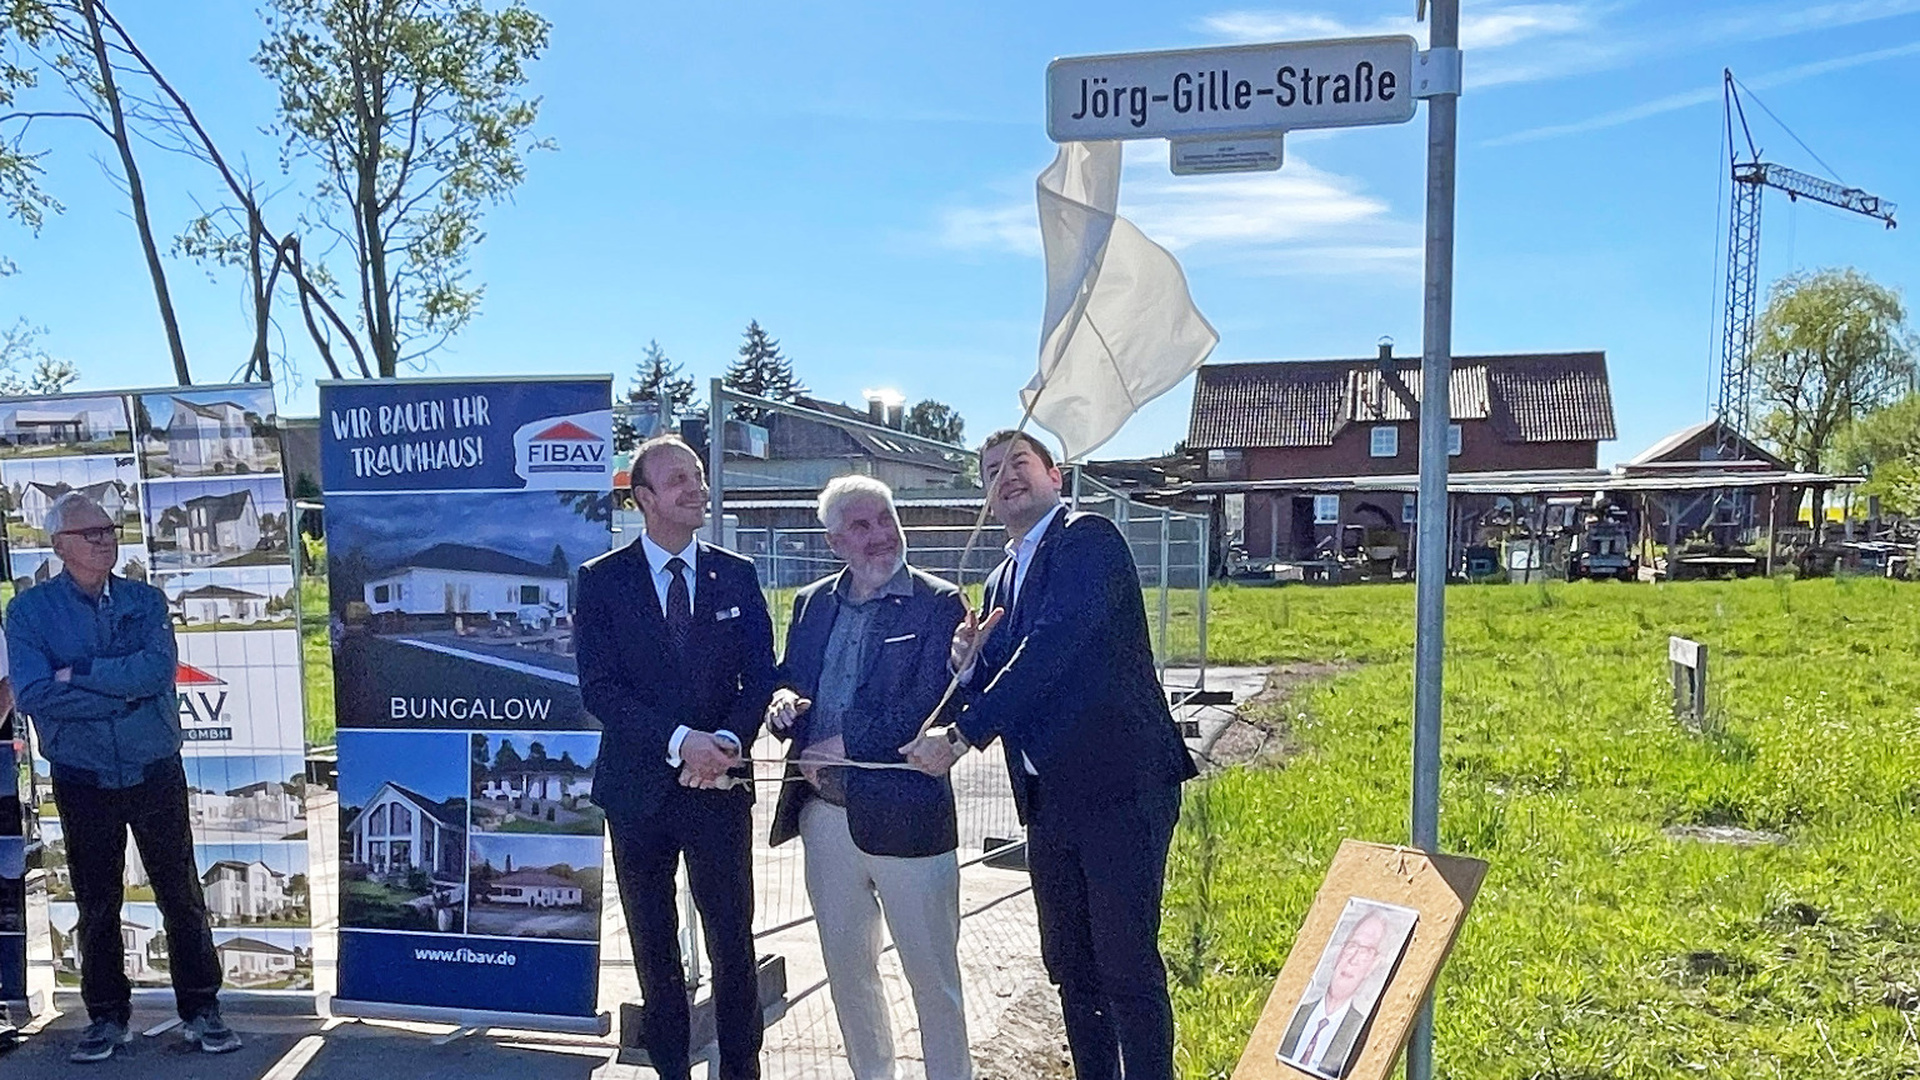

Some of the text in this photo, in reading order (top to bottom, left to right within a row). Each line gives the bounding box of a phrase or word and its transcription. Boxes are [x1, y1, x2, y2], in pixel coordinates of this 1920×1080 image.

[1071, 60, 1397, 128] Jörg-Gille-Straße
[331, 394, 491, 441] WIR BAUEN IHR
[350, 435, 484, 478] TRAUMHAUS!
[528, 444, 605, 462] FIBAV
[390, 696, 552, 721] BUNGALOW
[414, 947, 517, 966] www.fibav.de
